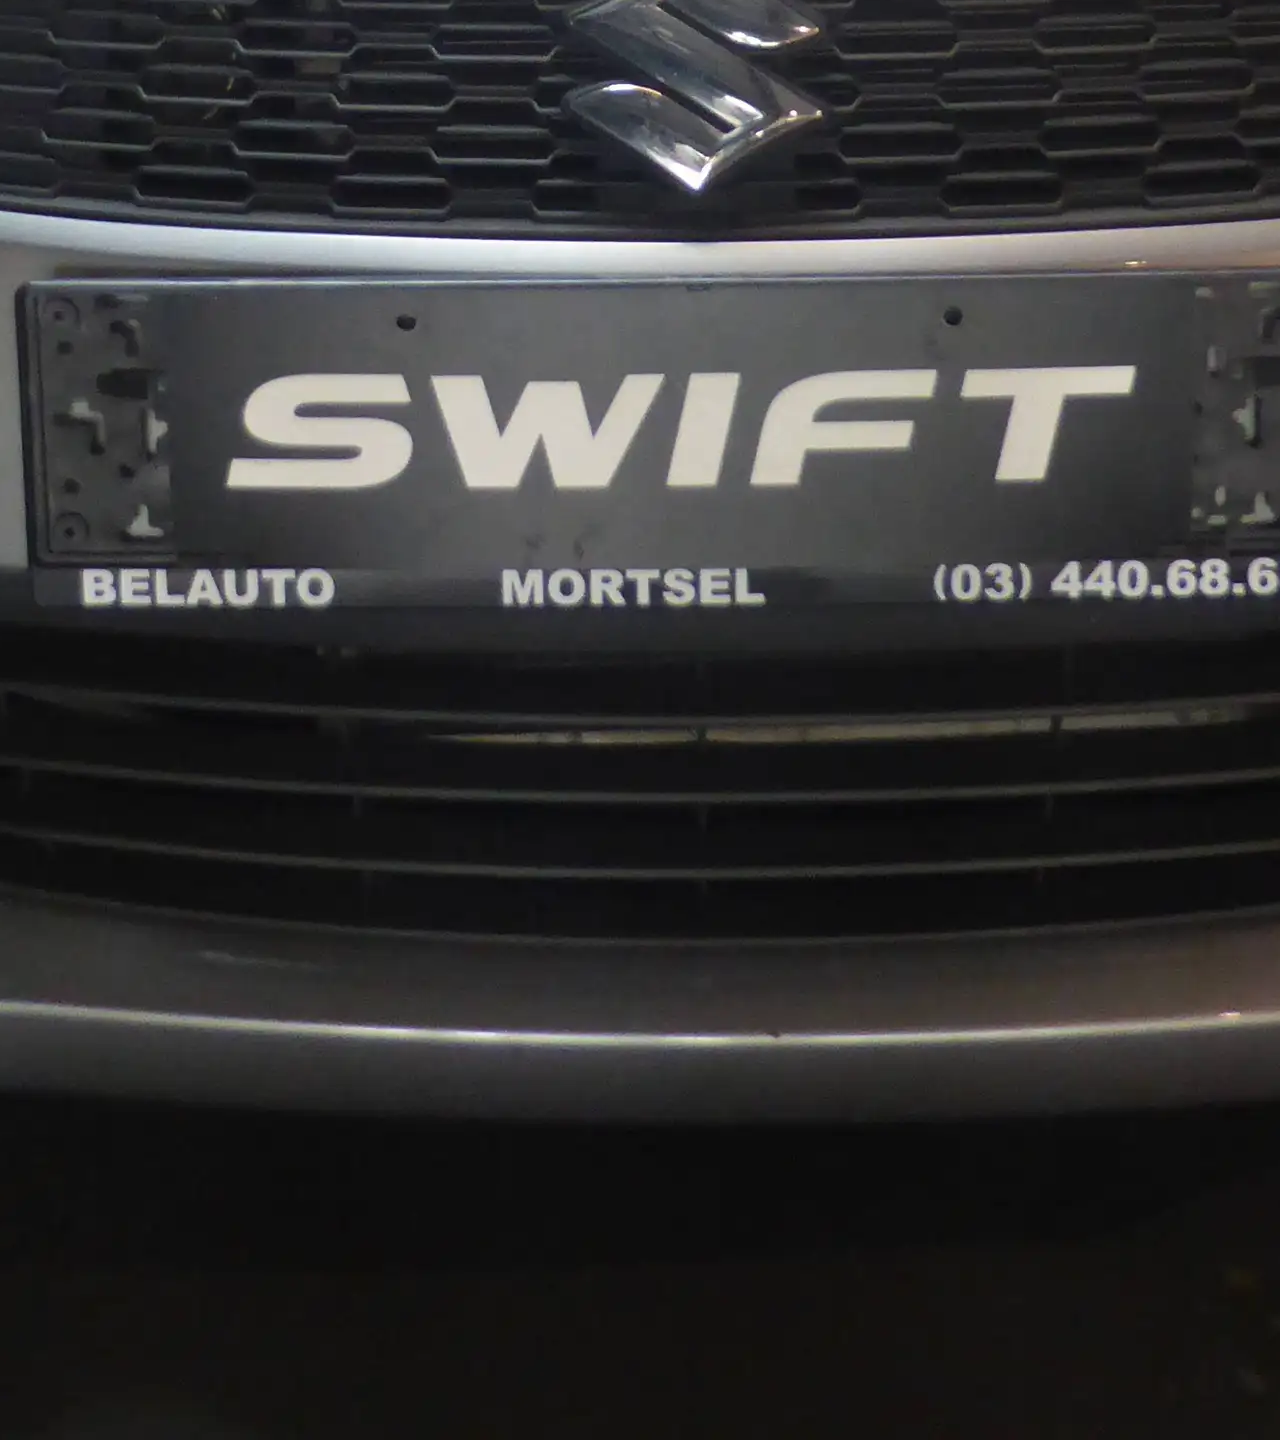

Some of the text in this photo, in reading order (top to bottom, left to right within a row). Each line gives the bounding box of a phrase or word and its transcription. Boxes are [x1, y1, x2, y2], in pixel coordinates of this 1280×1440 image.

[225, 365, 1137, 490] SWIFT
[81, 568, 336, 607] BELAUTO
[501, 567, 766, 607] MORTSEL
[933, 563, 1032, 601] (03)
